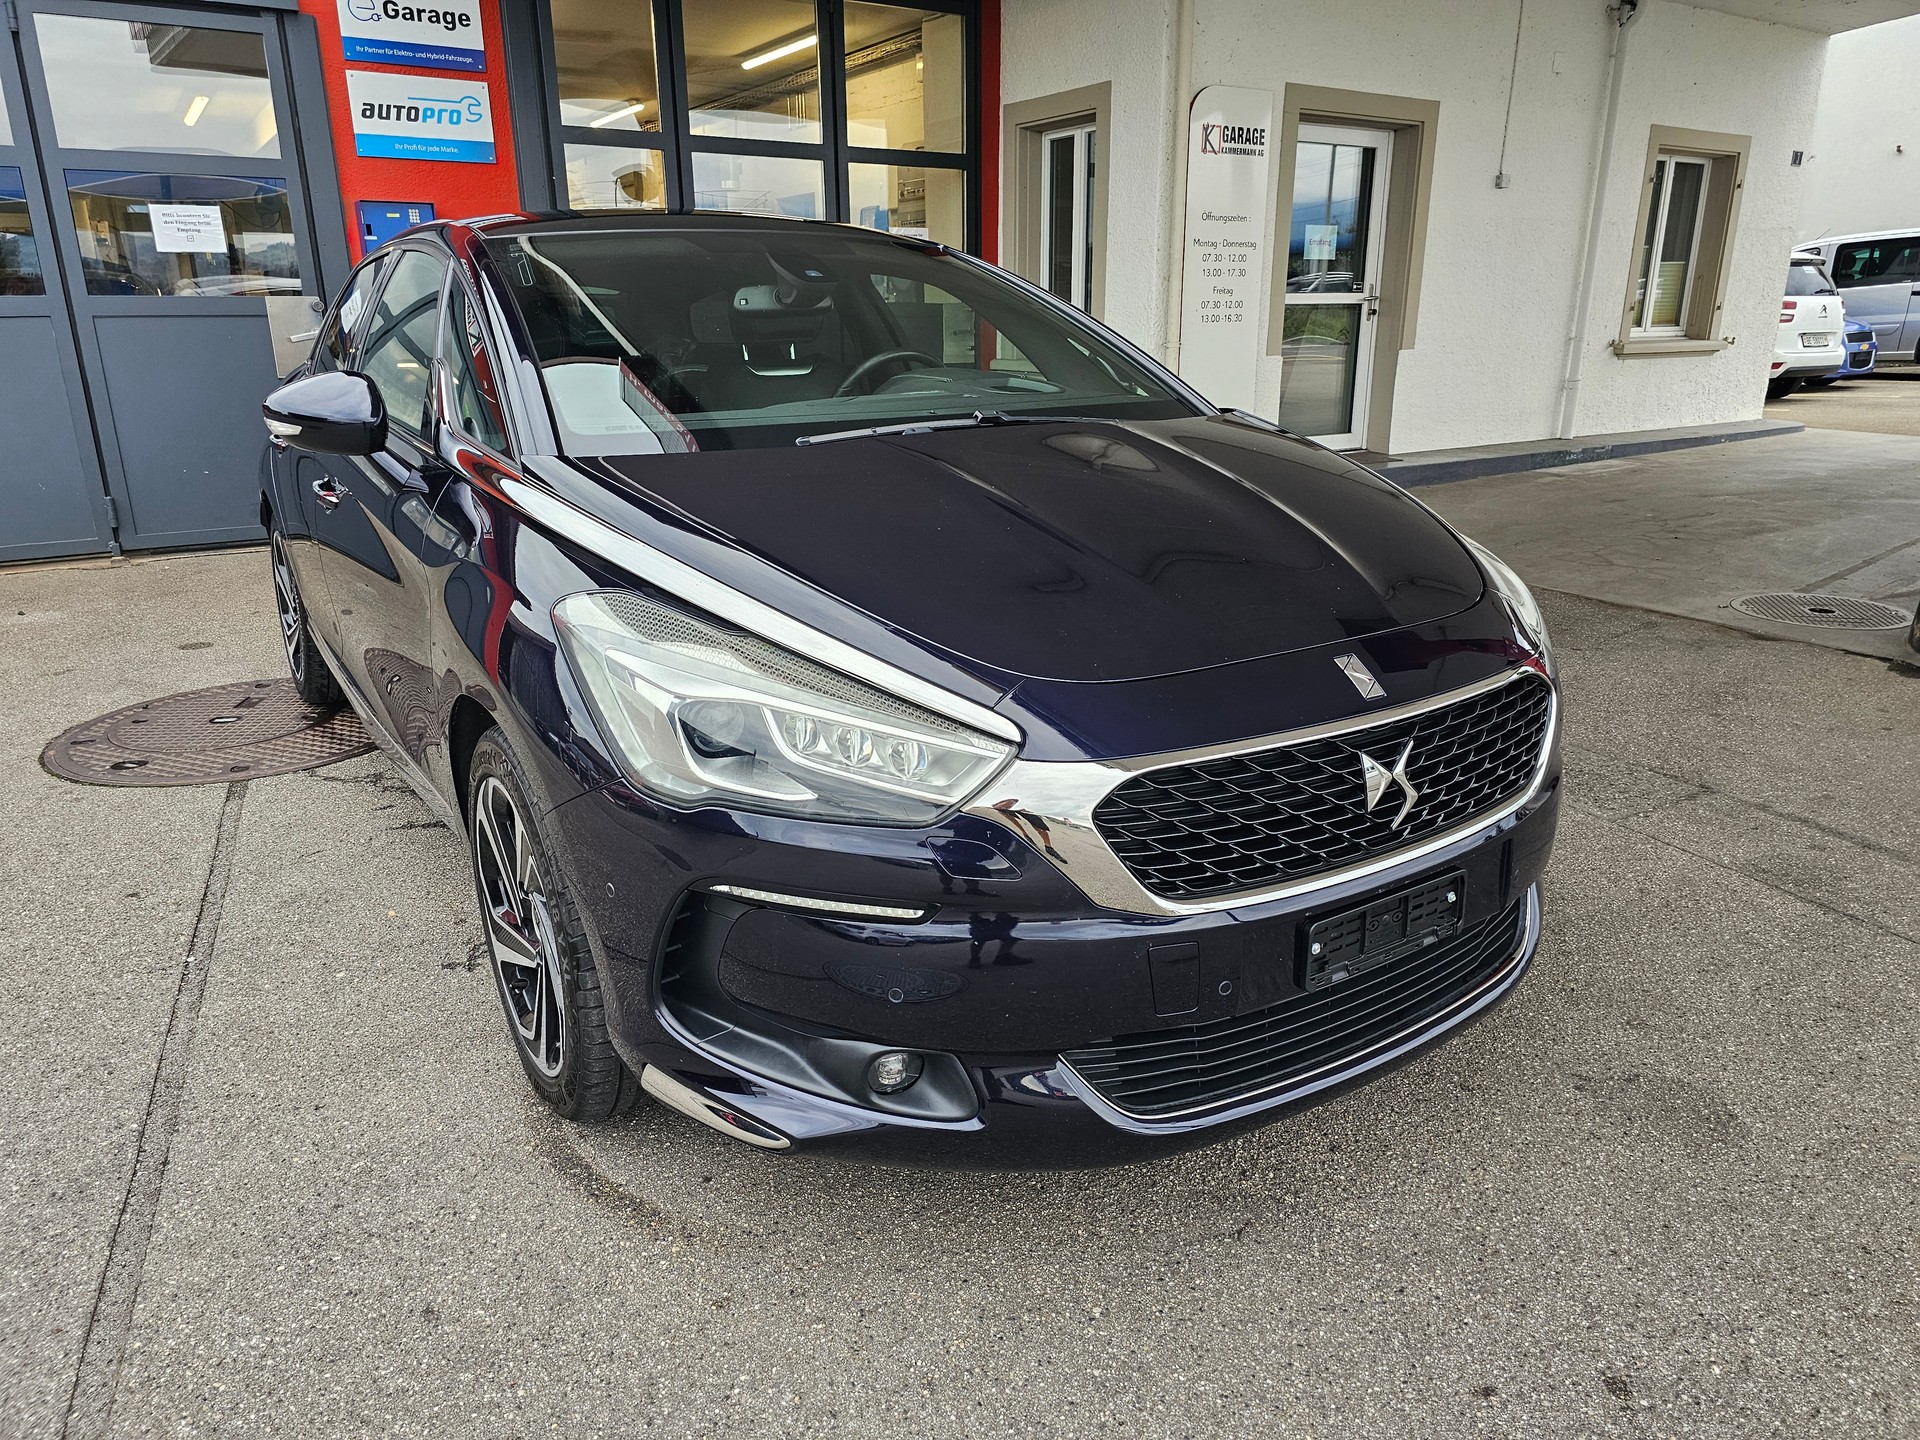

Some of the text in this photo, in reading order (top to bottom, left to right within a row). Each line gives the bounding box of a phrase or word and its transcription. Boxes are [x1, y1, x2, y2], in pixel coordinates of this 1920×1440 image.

[382, 0, 471, 31] Garage
[394, 49, 415, 57] Elektro-
[1222, 125, 1266, 146] GARAGE
[404, 143, 417, 151] Profi
[440, 146, 460, 154] Marke.
[1221, 147, 1265, 157] KAMMERMANN AG
[1201, 210, 1248, 224] Öffnungszeiten
[1193, 238, 1218, 250] Montag
[1222, 238, 1257, 250] Donnerstag
[1202, 253, 1222, 262] 07.30
[1228, 253, 1247, 262] 12.00
[1202, 268, 1222, 277] 13.00
[1227, 268, 1246, 277] 17.30
[1212, 286, 1234, 297] Freitag
[1201, 300, 1221, 309] 07.30
[1201, 314, 1221, 323] 13.00
